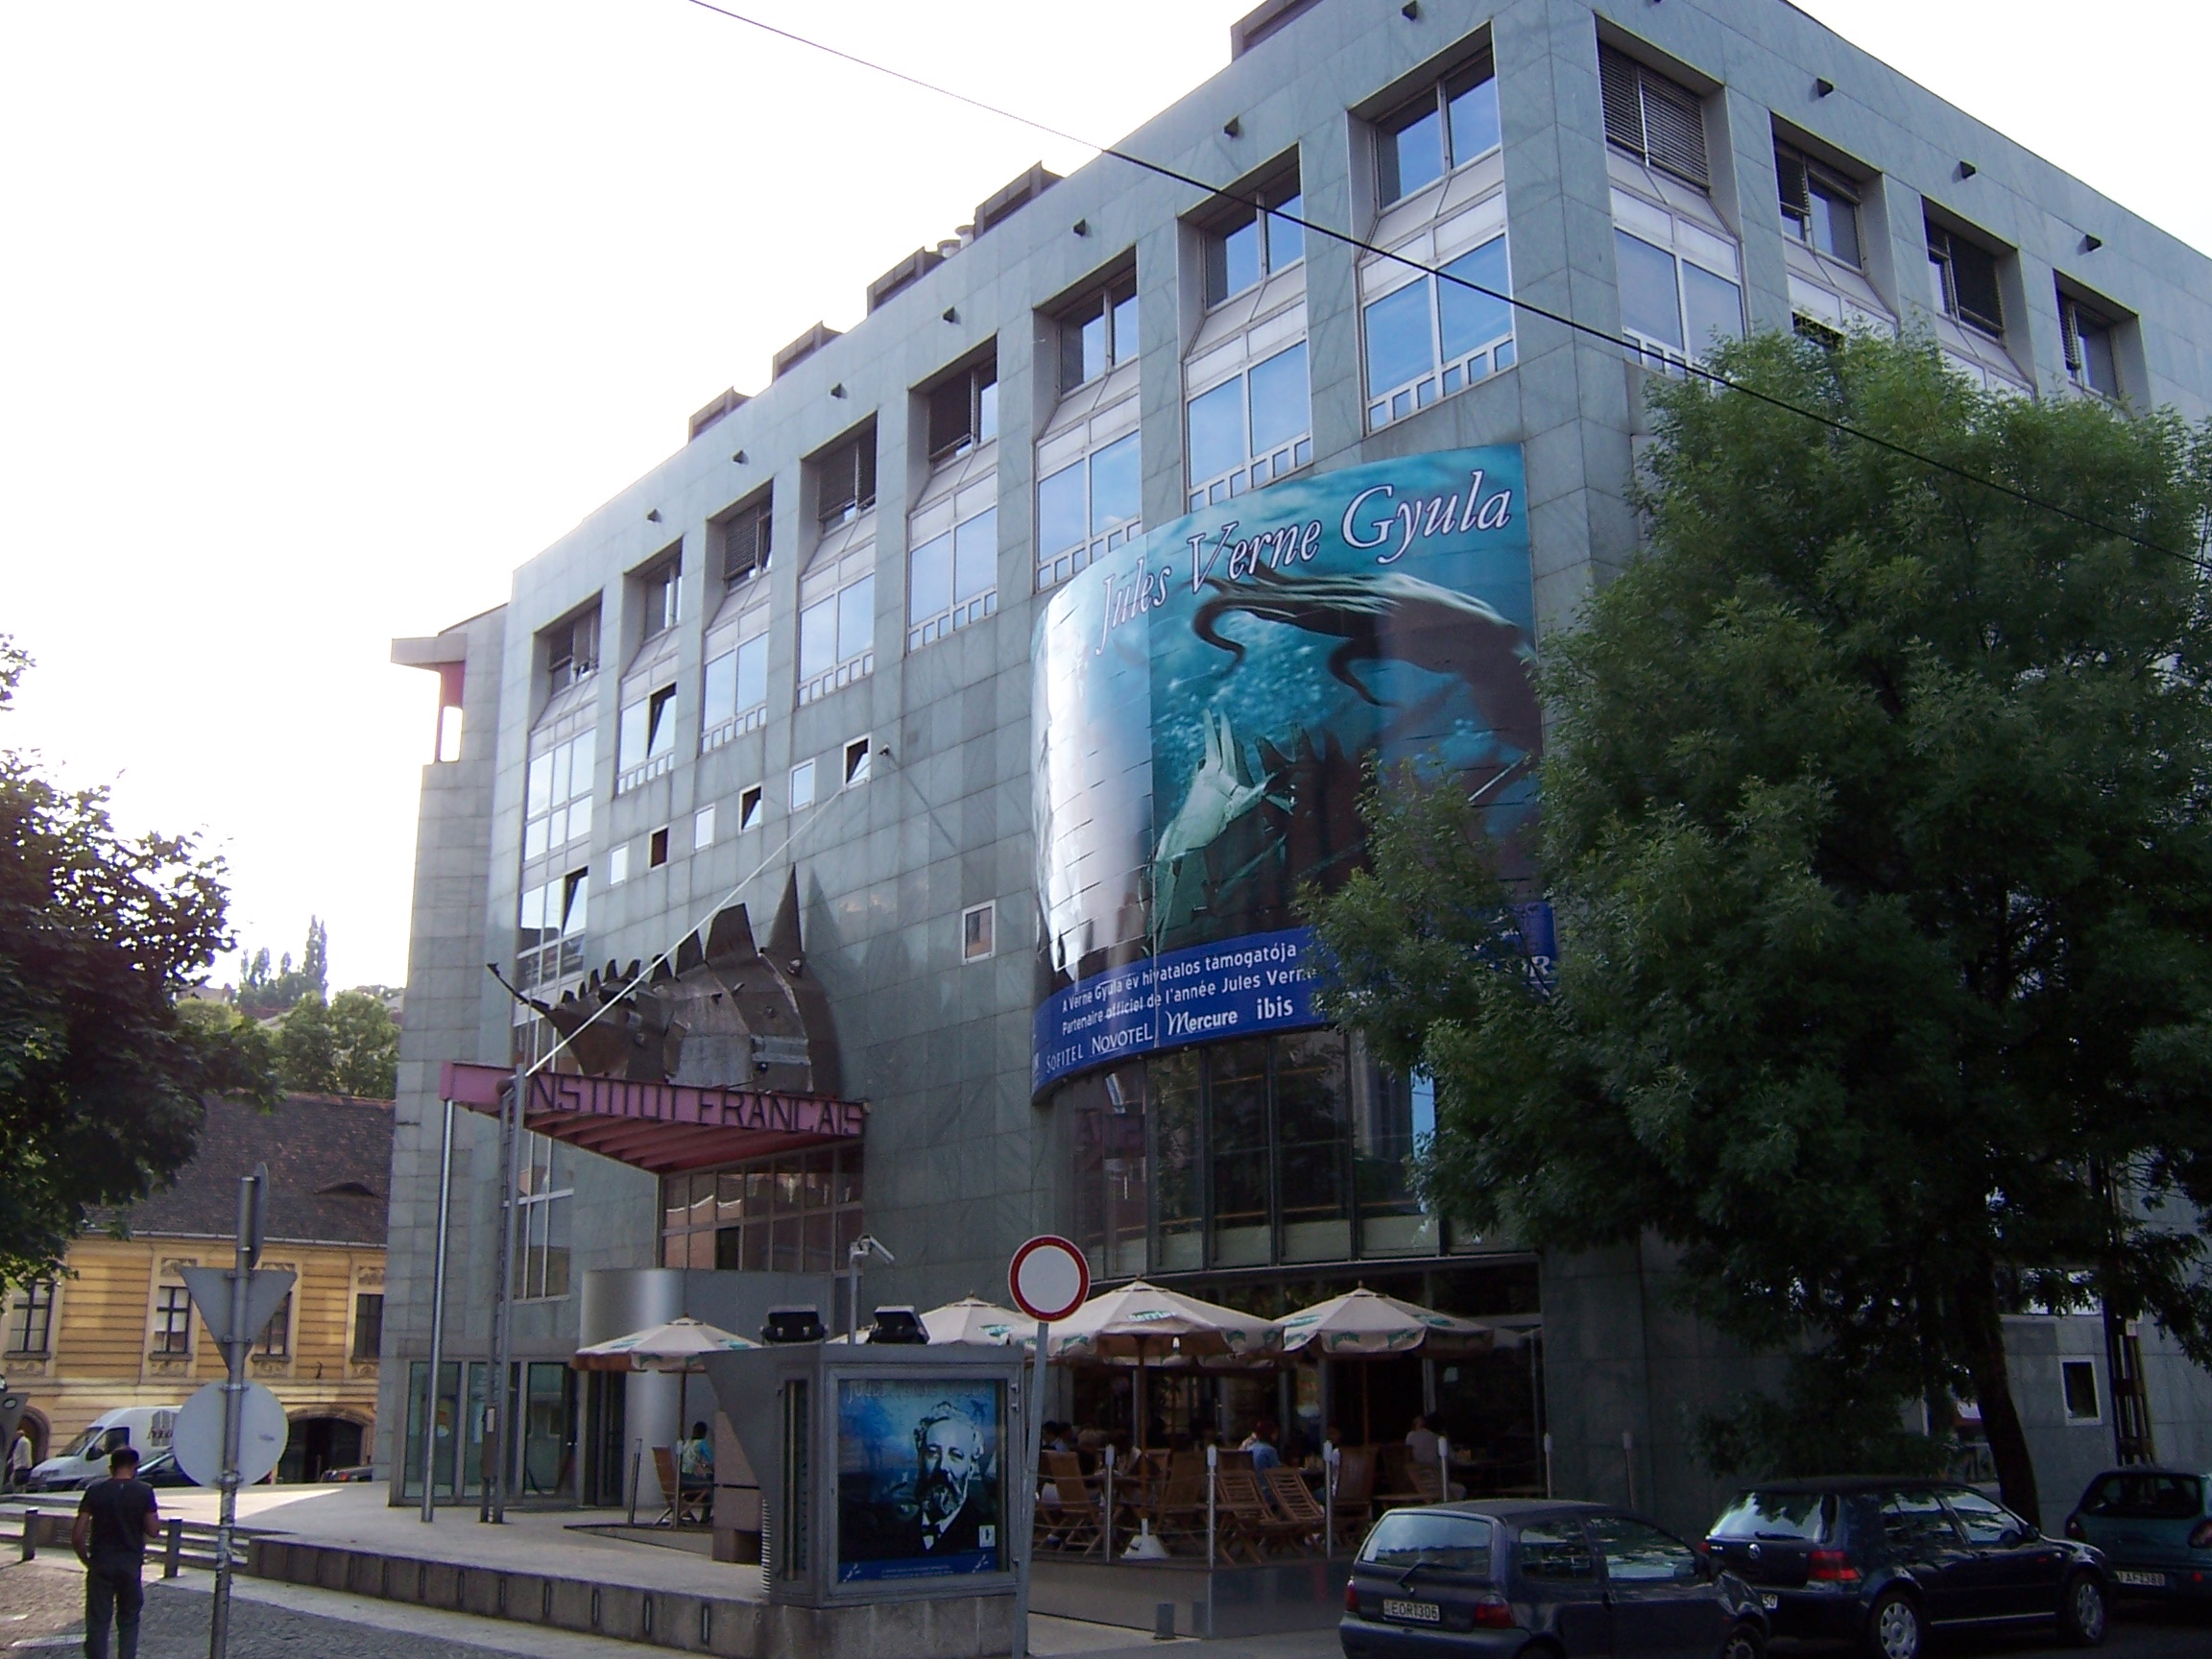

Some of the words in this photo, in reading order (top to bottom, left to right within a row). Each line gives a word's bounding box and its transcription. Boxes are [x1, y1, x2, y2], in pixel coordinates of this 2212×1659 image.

[1094, 557, 1171, 656] Jules
[1187, 521, 1322, 594] Verne
[1341, 469, 1512, 565] Gyula
[1062, 1010, 1103, 1036] Partenaire
[1106, 997, 1143, 1019] officiel
[1146, 994, 1162, 1008] de
[1221, 974, 1262, 994] Jules
[1069, 991, 1093, 1010] Verne
[1094, 979, 1122, 1001] Gyula
[1142, 961, 1200, 986] hivatalos
[1205, 942, 1296, 972] támogatója
[1046, 1044, 1084, 1073] SOFITEL
[1092, 1022, 1153, 1055] NOVOTEL
[1165, 1010, 1238, 1036] Mercure
[1257, 996, 1294, 1020] ibis
